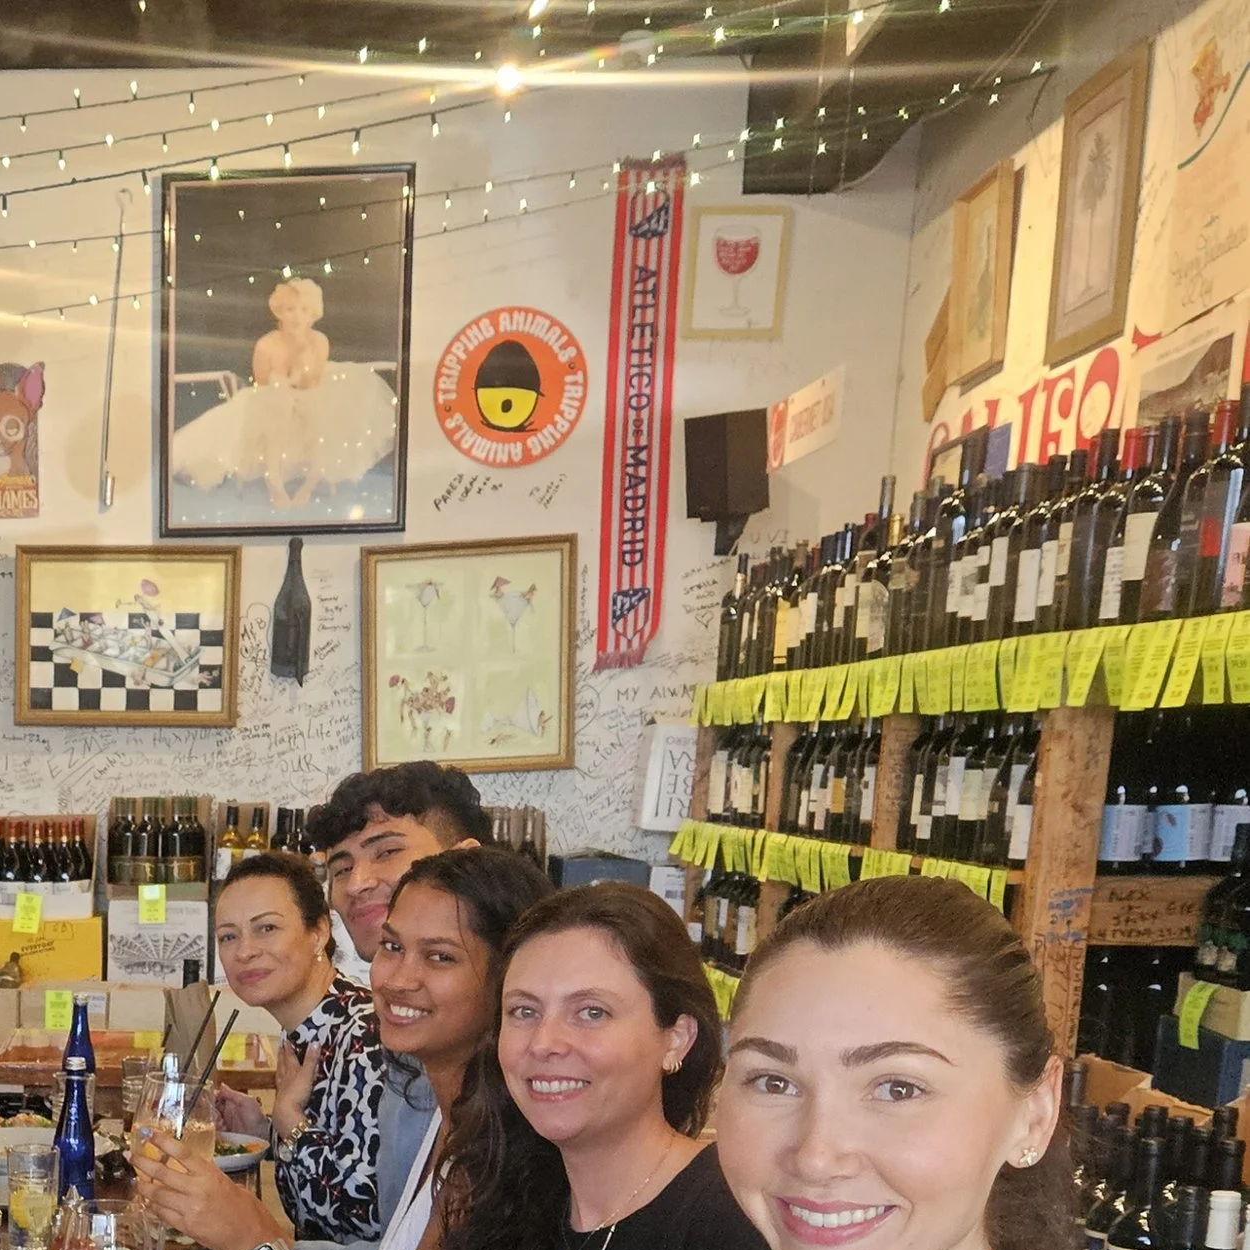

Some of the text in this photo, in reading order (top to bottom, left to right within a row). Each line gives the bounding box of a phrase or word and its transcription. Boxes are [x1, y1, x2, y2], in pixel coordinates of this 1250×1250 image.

[438, 310, 578, 405] TRIPPING ANIMALS
[446, 370, 584, 463] TRIPPING ANIMALS
[632, 418, 644, 437] DE
[622, 444, 648, 567] MADRID
[617, 686, 639, 702] MY
